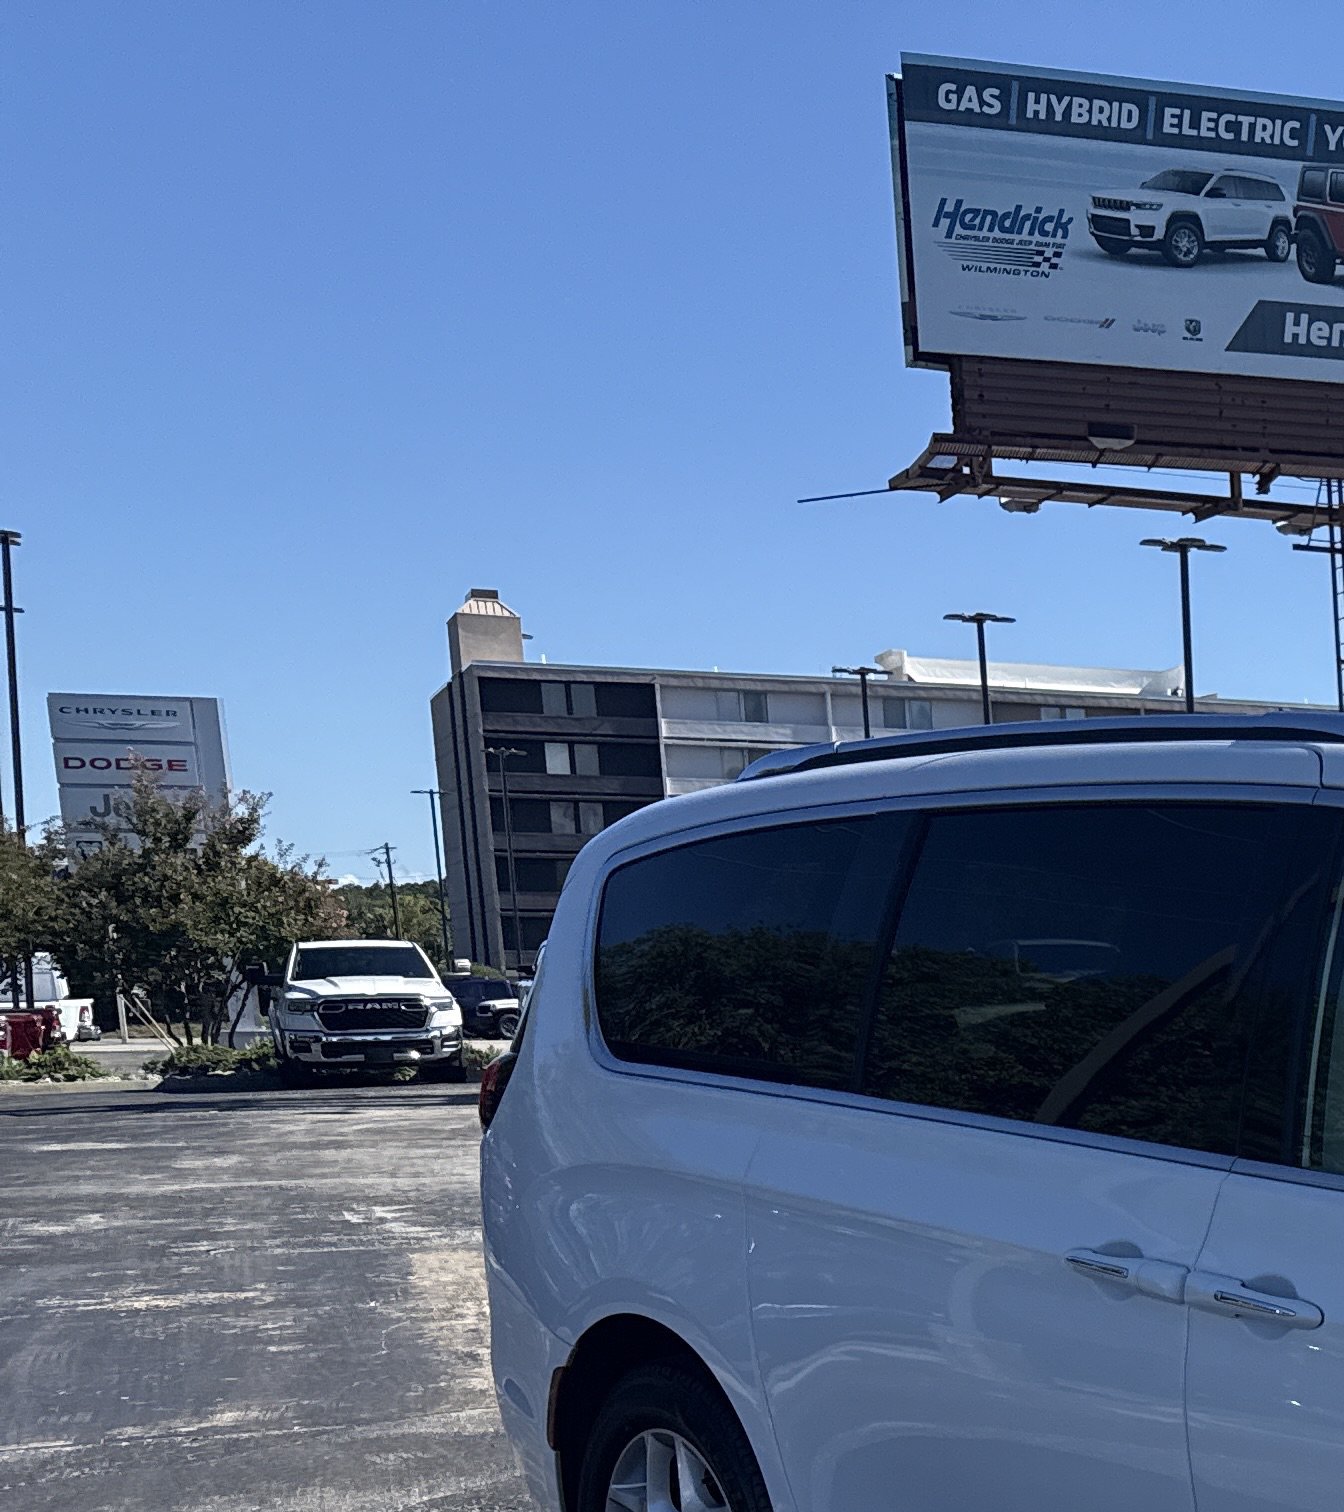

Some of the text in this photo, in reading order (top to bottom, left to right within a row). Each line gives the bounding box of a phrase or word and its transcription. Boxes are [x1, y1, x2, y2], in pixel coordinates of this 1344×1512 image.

[937, 82, 1002, 116] GAS
[1025, 91, 1140, 131] HYBRID
[1162, 107, 1301, 148] ELECTRIC
[931, 197, 1074, 240] Hendrick
[961, 263, 1051, 279] WILMINGTON
[58, 705, 178, 717] CHRYSLER
[63, 756, 189, 772] DODGE
[347, 1002, 399, 1010] RAM
